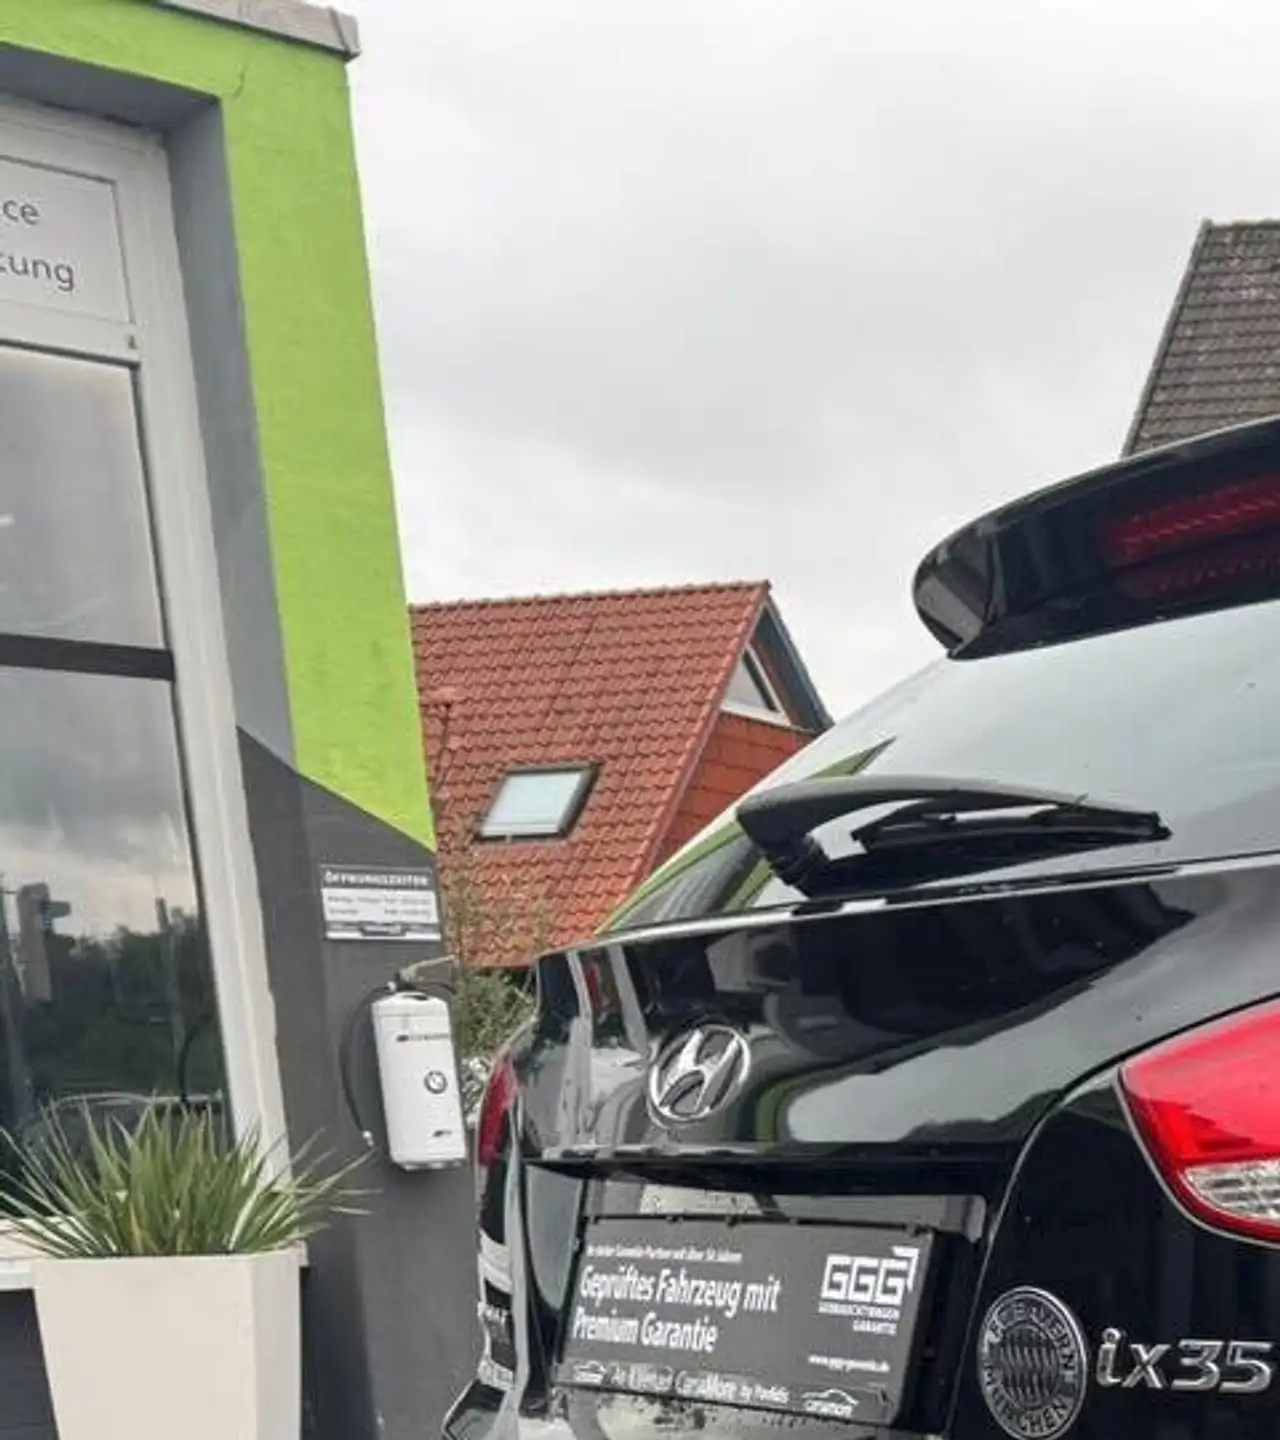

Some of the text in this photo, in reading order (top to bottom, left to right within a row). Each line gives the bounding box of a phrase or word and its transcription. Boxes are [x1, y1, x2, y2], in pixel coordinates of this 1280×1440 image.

[579, 1264, 780, 1318] Geprüftes Fahrzeug mit
[820, 1253, 908, 1306] GGG
[572, 1305, 718, 1353] Premium Garantie
[1096, 1326, 1276, 1394] ix35
